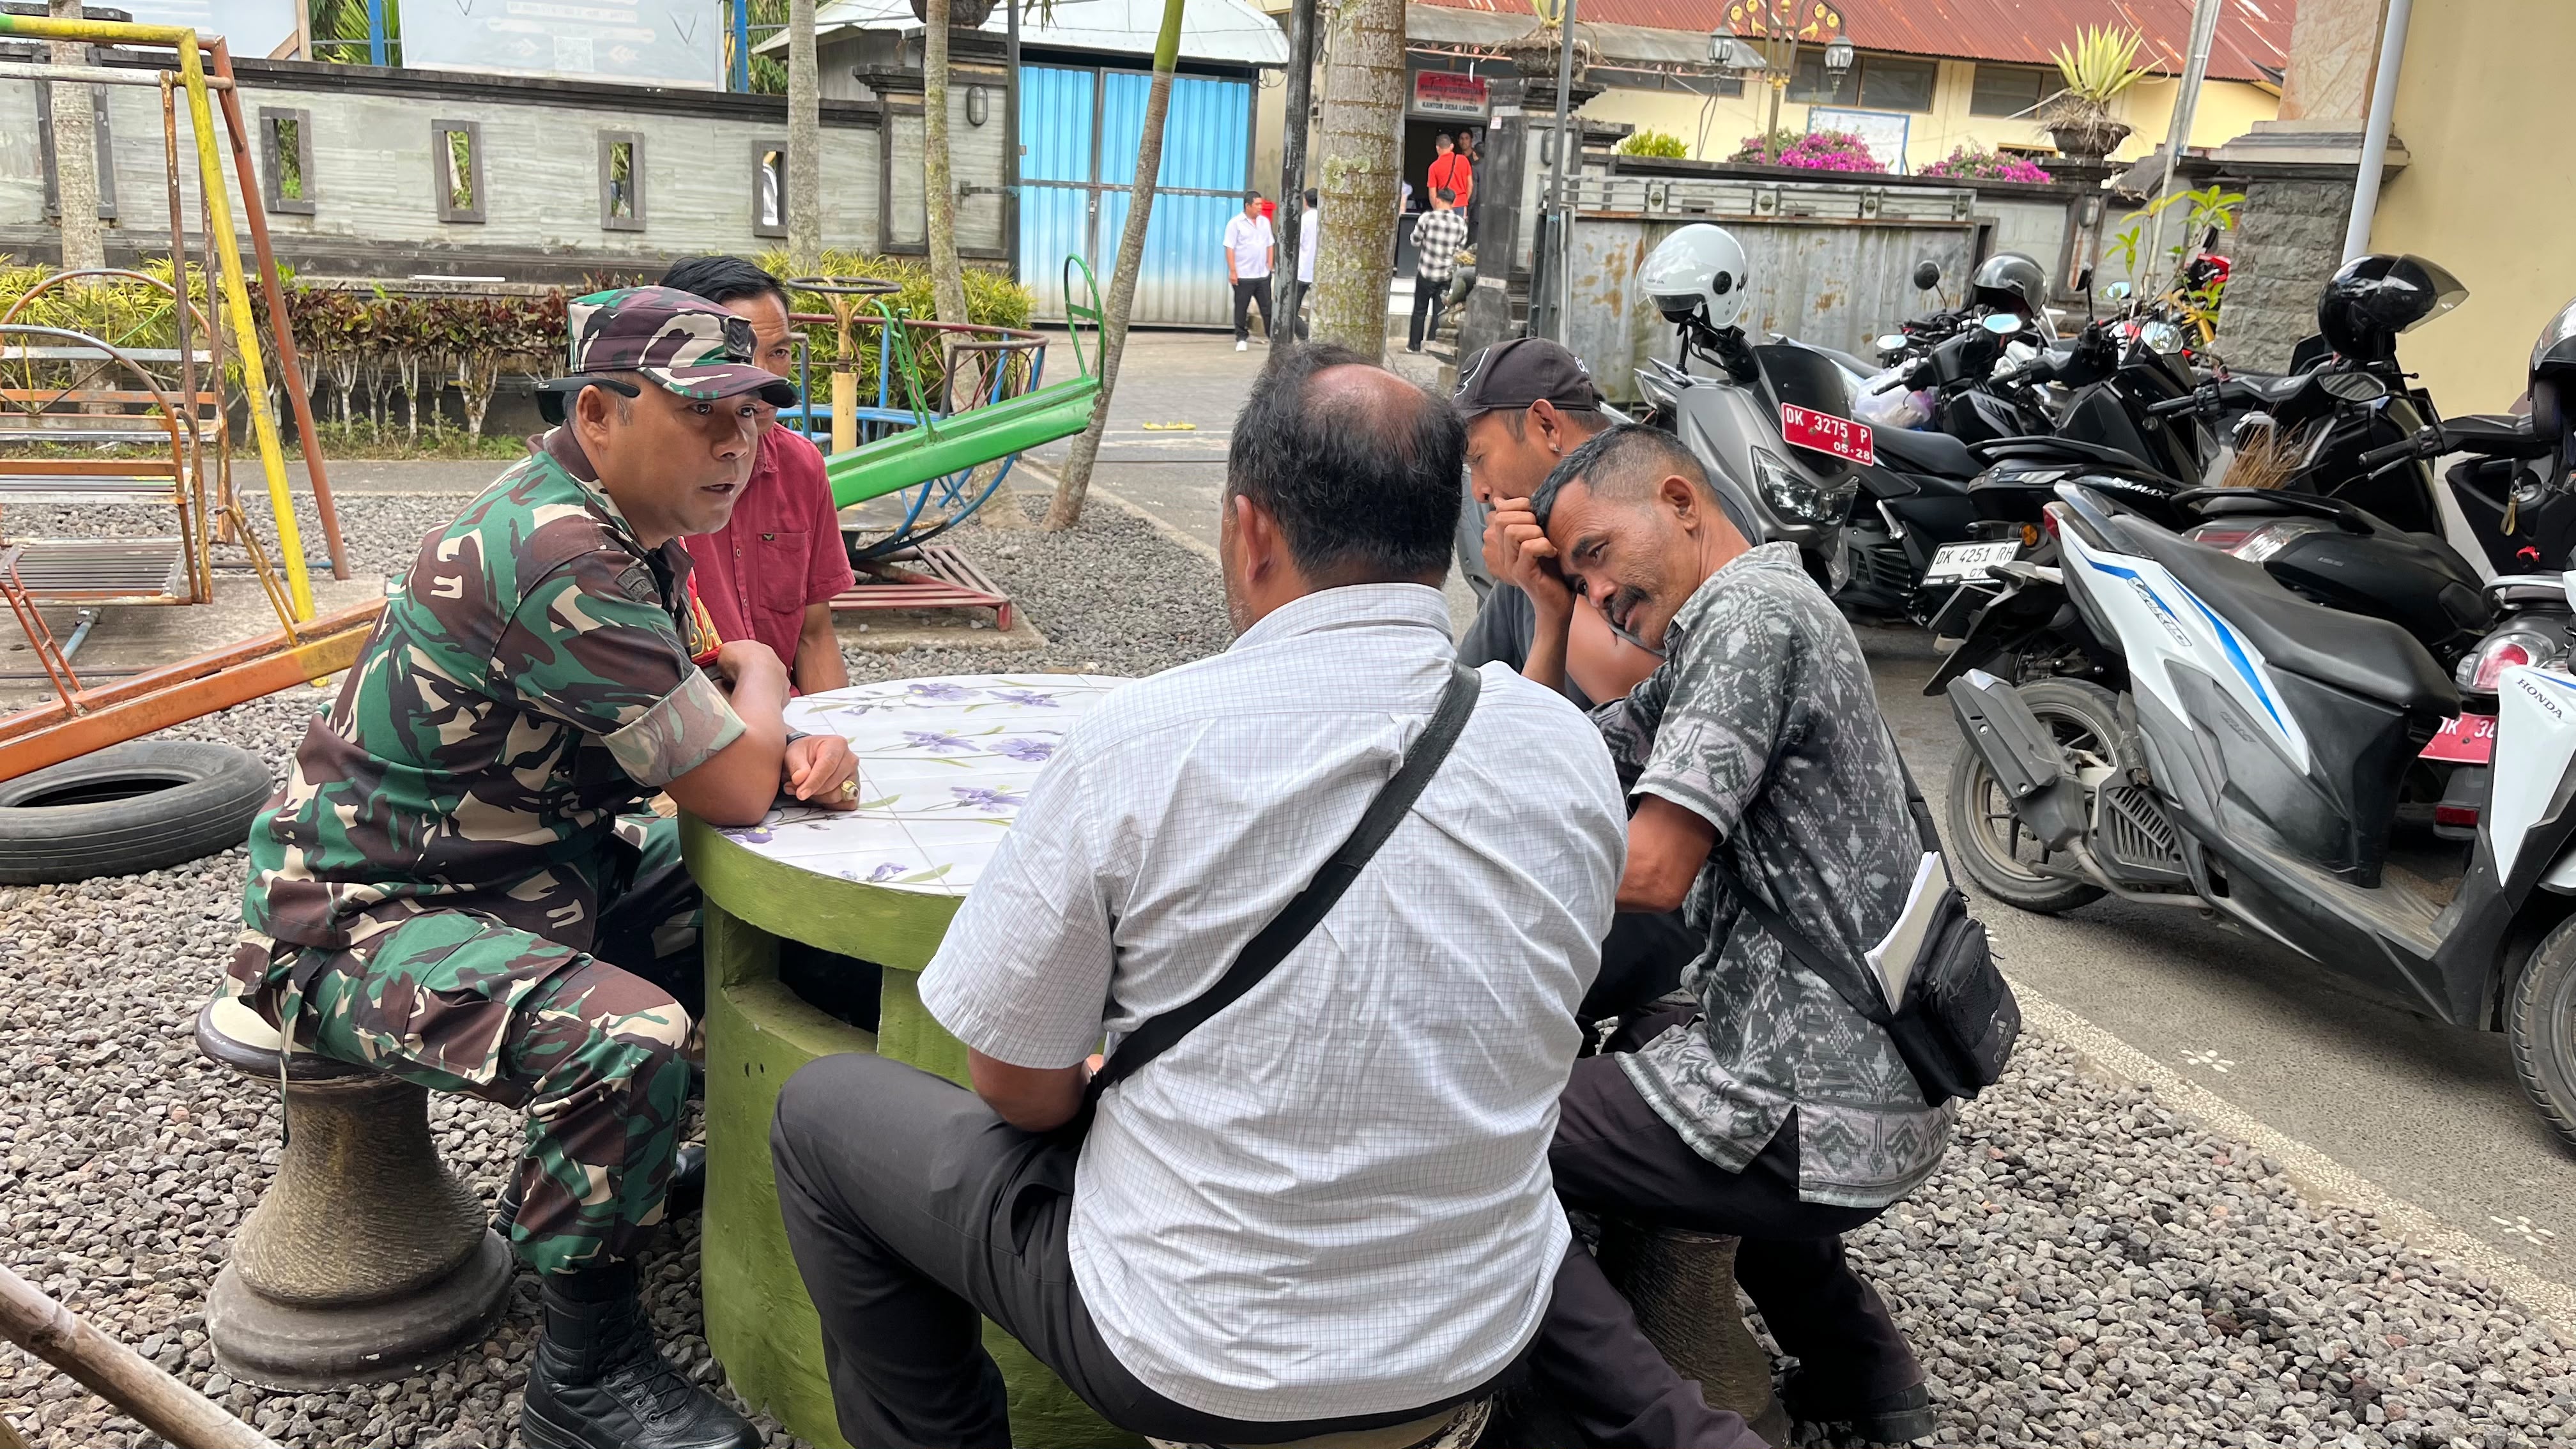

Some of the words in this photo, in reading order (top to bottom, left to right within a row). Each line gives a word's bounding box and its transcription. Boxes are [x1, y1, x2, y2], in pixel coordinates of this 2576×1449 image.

[1786, 407, 1804, 427] DK
[1814, 415, 1848, 438] 3275
[1860, 428, 1867, 443] P
[1936, 549, 1954, 565] DK
[1959, 546, 1991, 563] 4251
[1995, 546, 2016, 562] RH
[2517, 677, 2563, 720] HONDA
